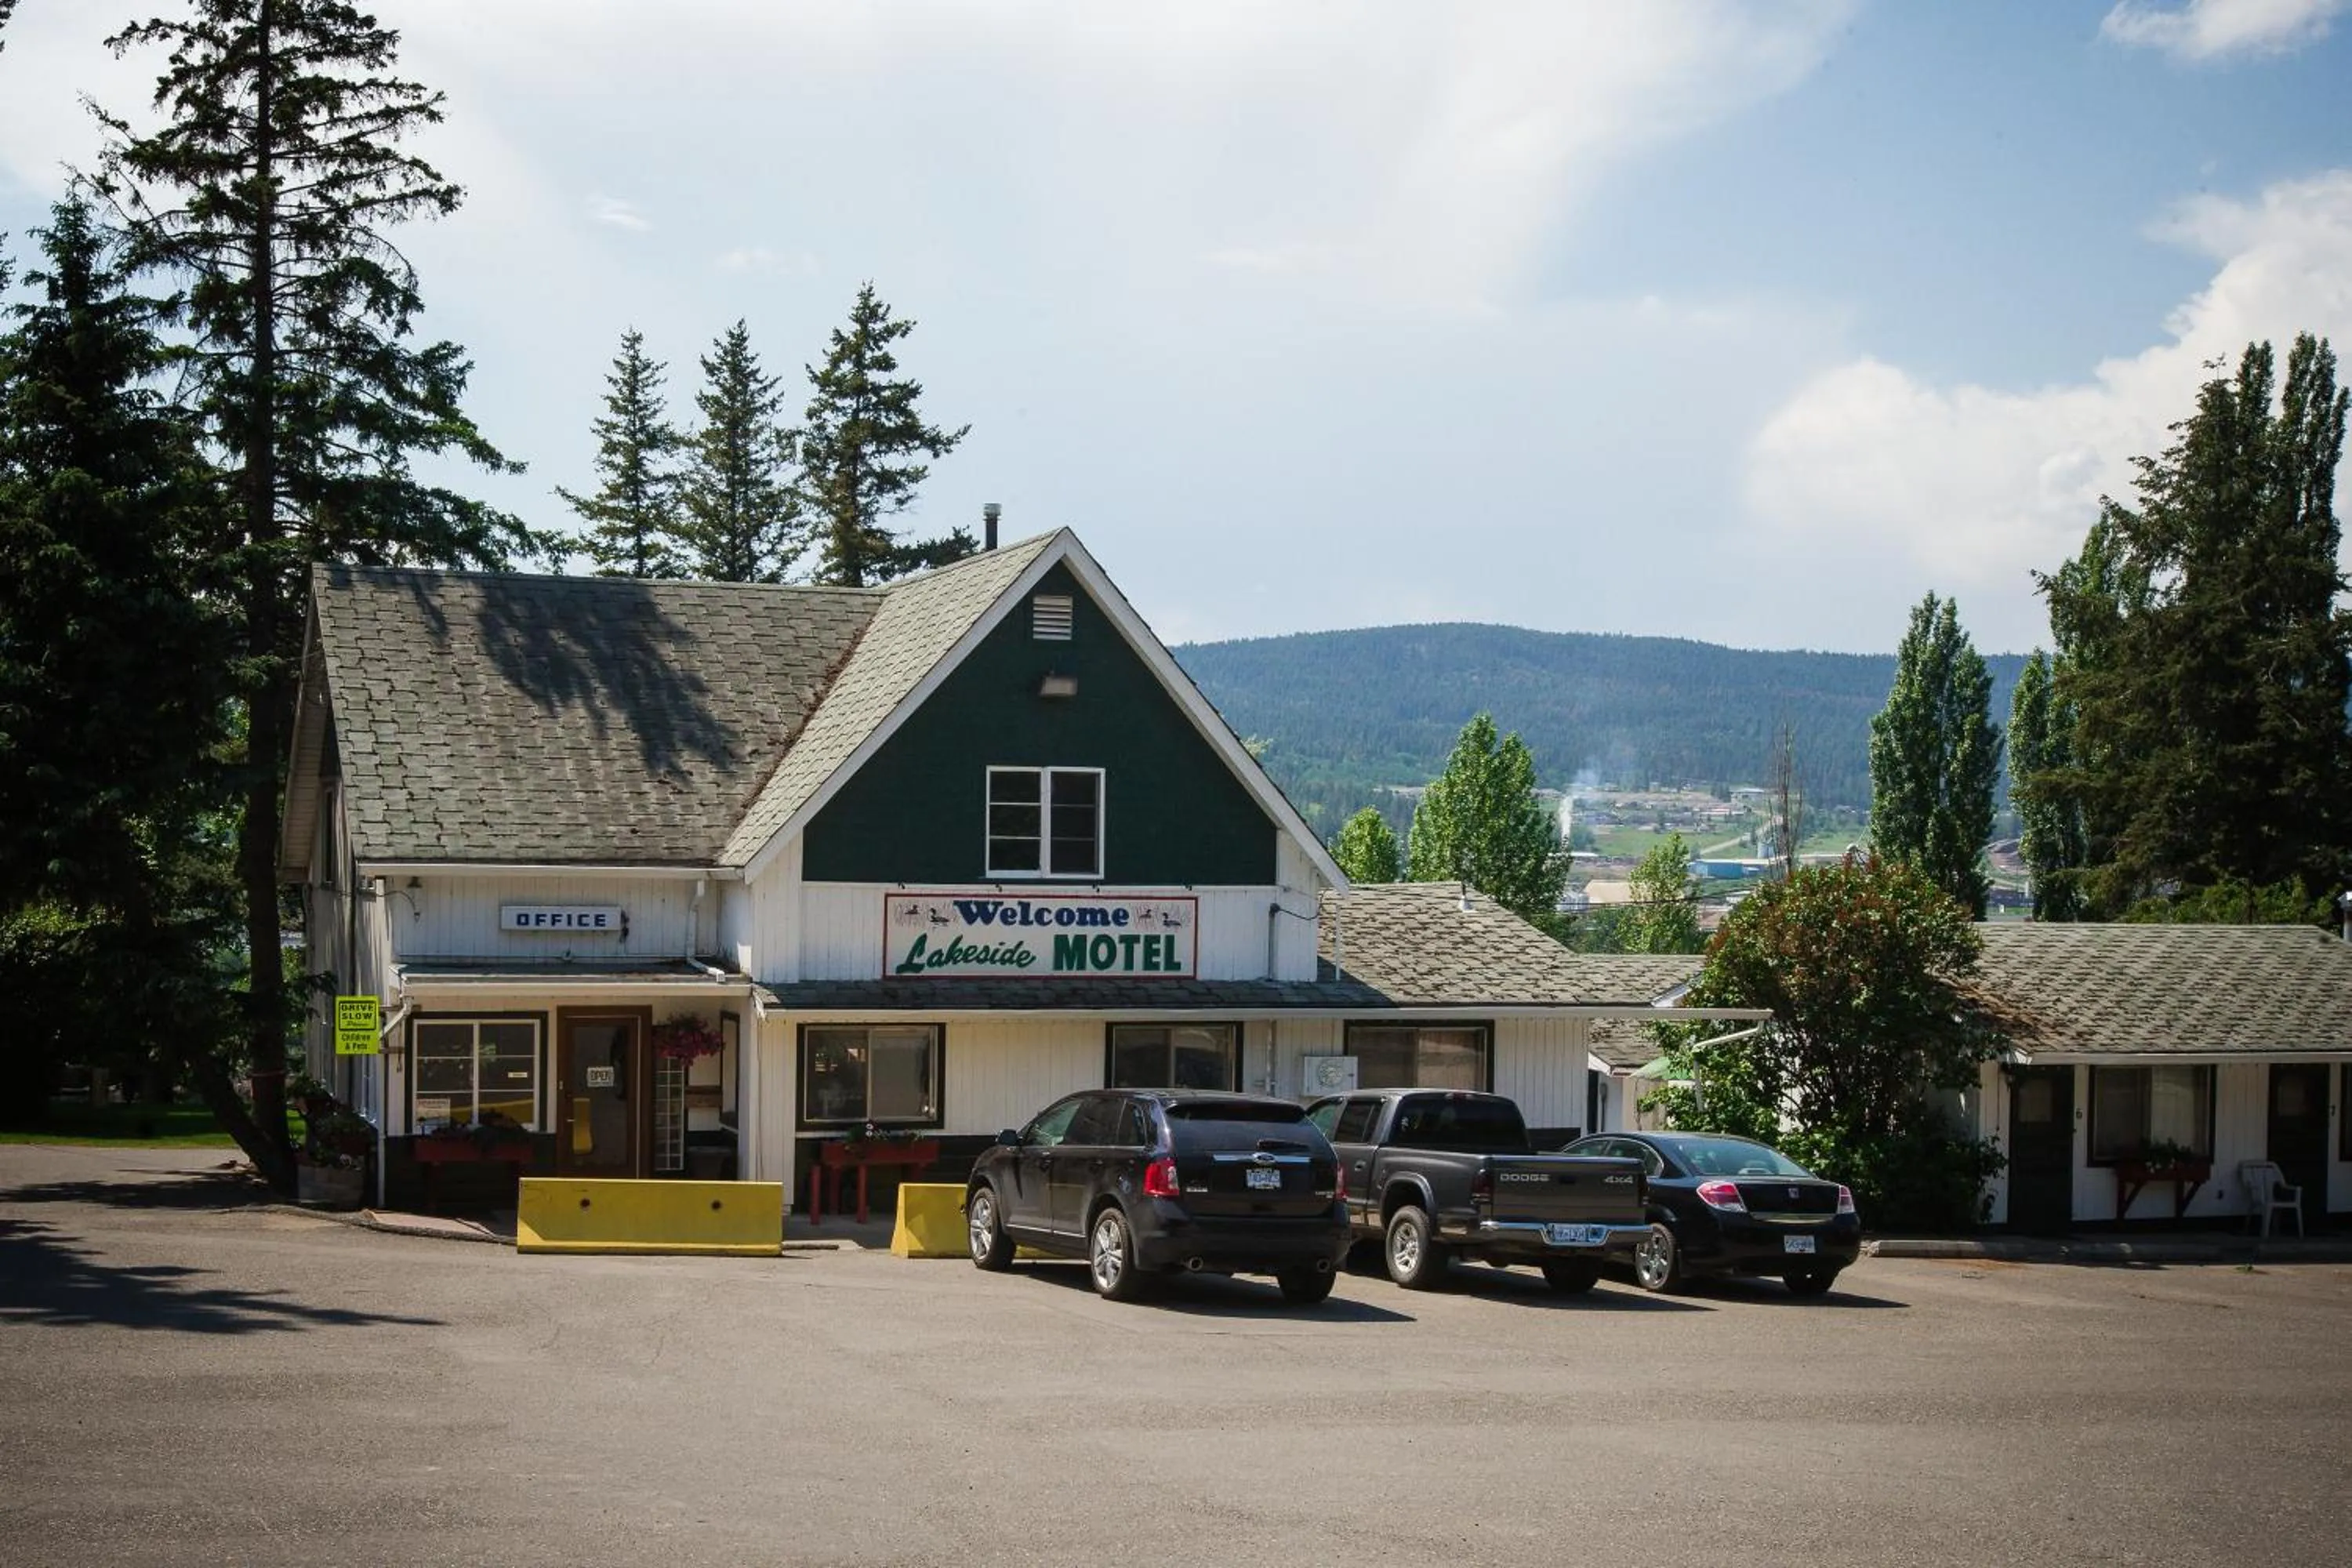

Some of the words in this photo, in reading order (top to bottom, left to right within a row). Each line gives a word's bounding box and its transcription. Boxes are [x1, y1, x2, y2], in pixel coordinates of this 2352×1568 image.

[516, 913, 607, 927] OFFICE
[953, 900, 1130, 927] Welcome
[895, 933, 1036, 975] Lakeside
[1052, 934, 1181, 971] MOTEL
[1500, 1173, 1550, 1181] DODGE
